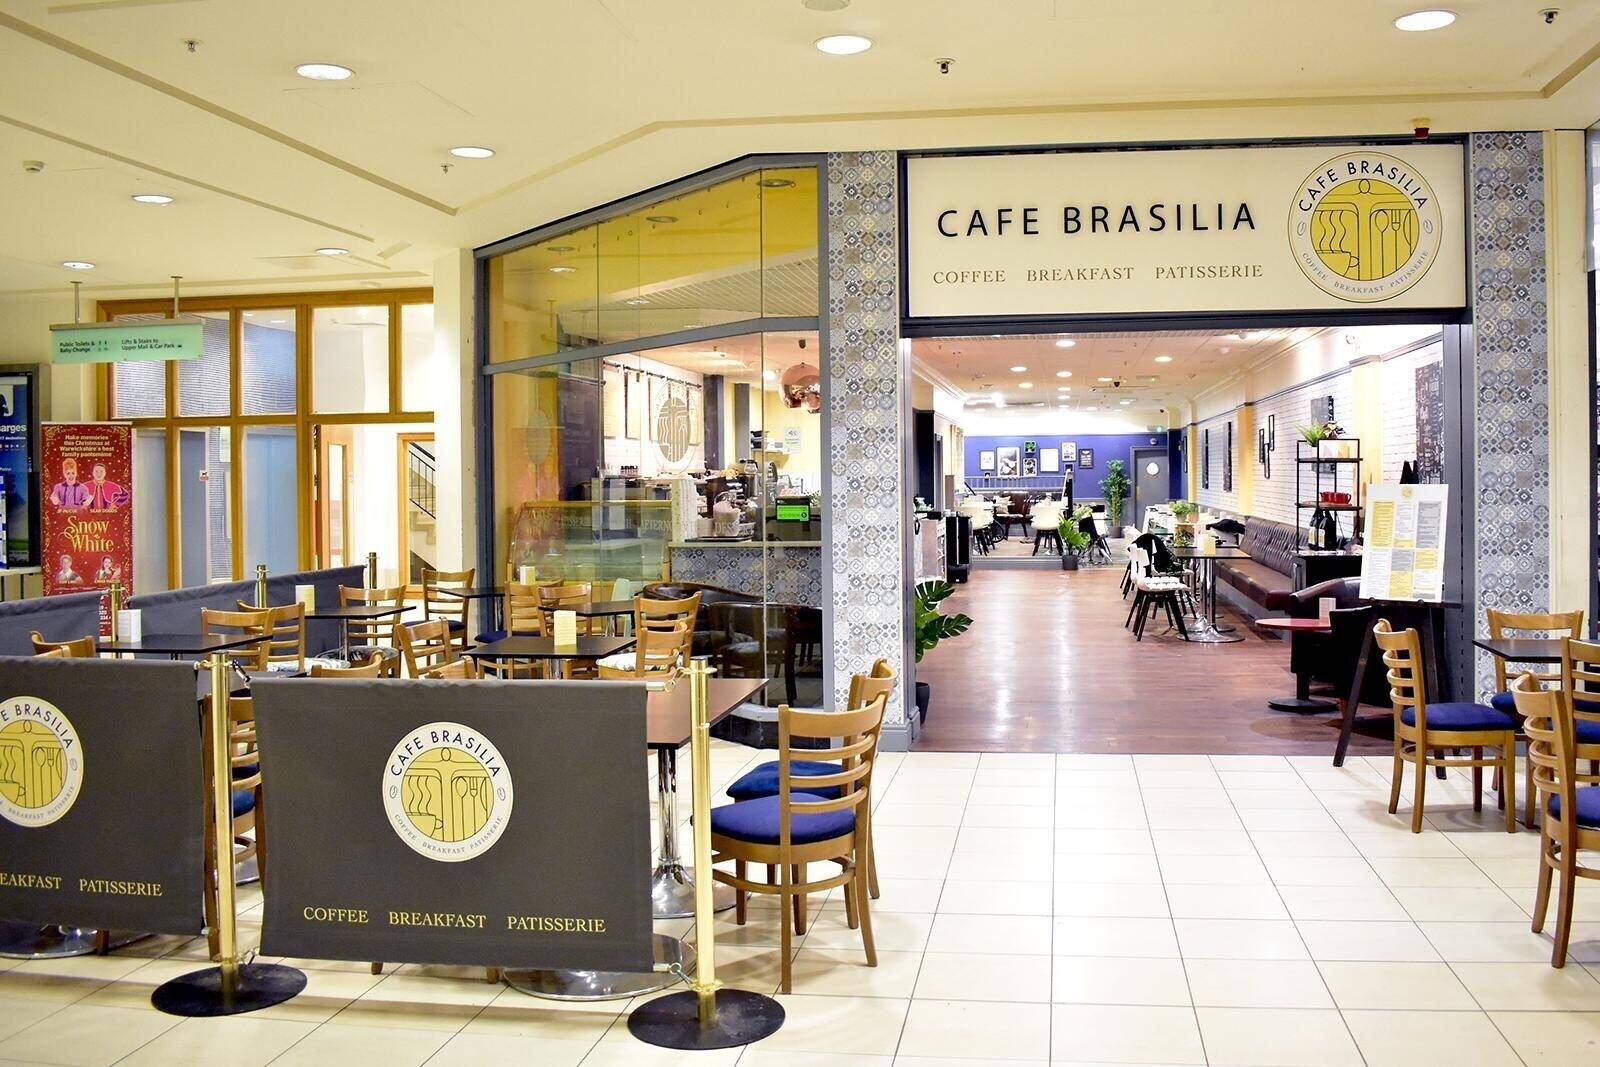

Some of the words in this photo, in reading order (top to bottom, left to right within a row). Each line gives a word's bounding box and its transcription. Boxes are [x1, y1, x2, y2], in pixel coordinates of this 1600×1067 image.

[1299, 168, 1339, 212] CAFE
[1347, 160, 1429, 210] BRASILIA
[937, 207, 1040, 238] CAFE
[1063, 202, 1257, 234] BRASILIA
[932, 269, 1007, 285] COFFEE
[1026, 266, 1136, 283] BREAKFAST
[1155, 263, 1264, 280] PATISSERIE
[1302, 251, 1328, 282] COFFEE
[1334, 281, 1386, 295] BREAKFAST
[1389, 250, 1430, 288] PATISSERIE
[64, 515, 109, 539] Snow
[71, 534, 115, 552] White
[15, 703, 73, 749] BRASILIA
[390, 736, 425, 776] CAFE
[430, 730, 501, 777] BRASILIA
[394, 813, 418, 841] COFFEE
[421, 842, 467, 854] BREAKFAST
[469, 816, 503, 850] PATISSERIE
[0, 872, 62, 890] EAKFAST
[79, 878, 163, 897] PATISSERIE
[303, 906, 369, 923] COFFEE
[388, 911, 487, 929] BREAKFAST
[506, 915, 607, 933] PATISSERIE
